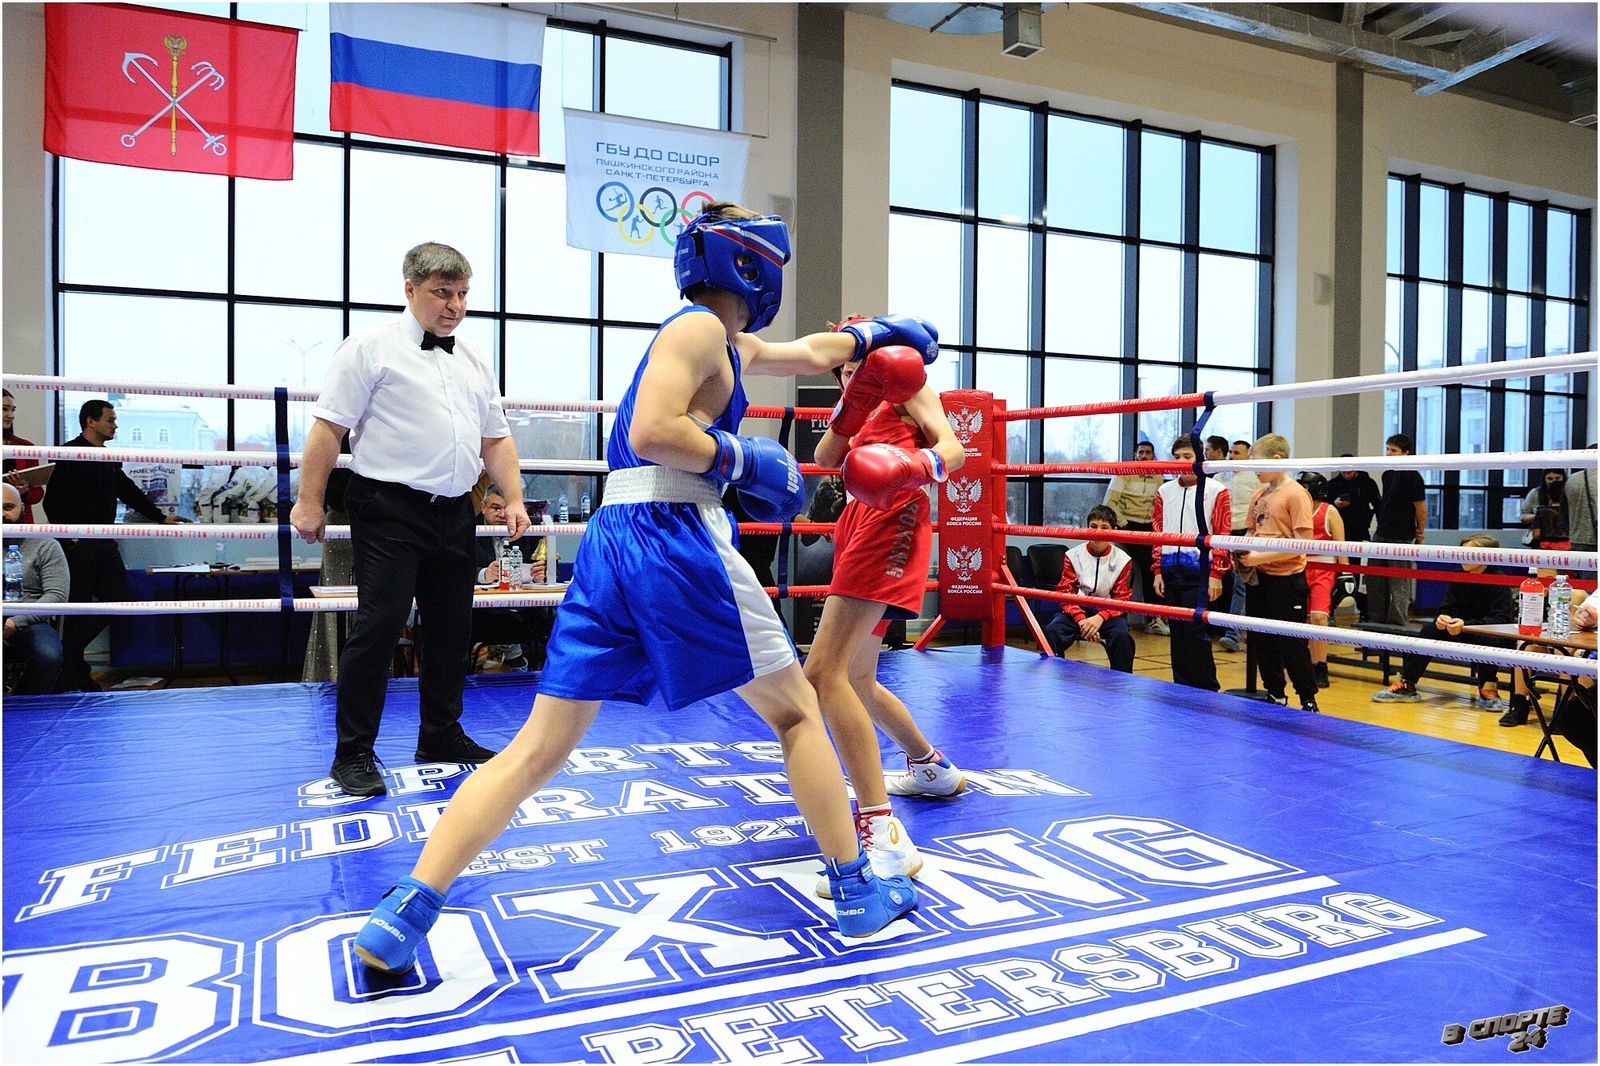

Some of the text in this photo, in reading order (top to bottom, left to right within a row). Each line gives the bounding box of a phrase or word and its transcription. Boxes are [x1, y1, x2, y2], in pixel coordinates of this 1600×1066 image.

[596, 142, 720, 167] ГБУ ДО СШОР
[596, 158, 720, 179] ПУШКИНСКОГО РАЙОНА
[605, 168, 710, 187] САНКТ-ПЕТЕРБУРГА
[1318, 543, 1343, 552] BOXING
[1346, 545, 1363, 554] TEAM
[1393, 547, 1420, 558] BOXING
[1508, 552, 1541, 565] BOXING
[1546, 555, 1569, 567] TEAM
[2, 814, 1307, 1064] BOXING
[580, 892, 1446, 1064] PETERSBURG
